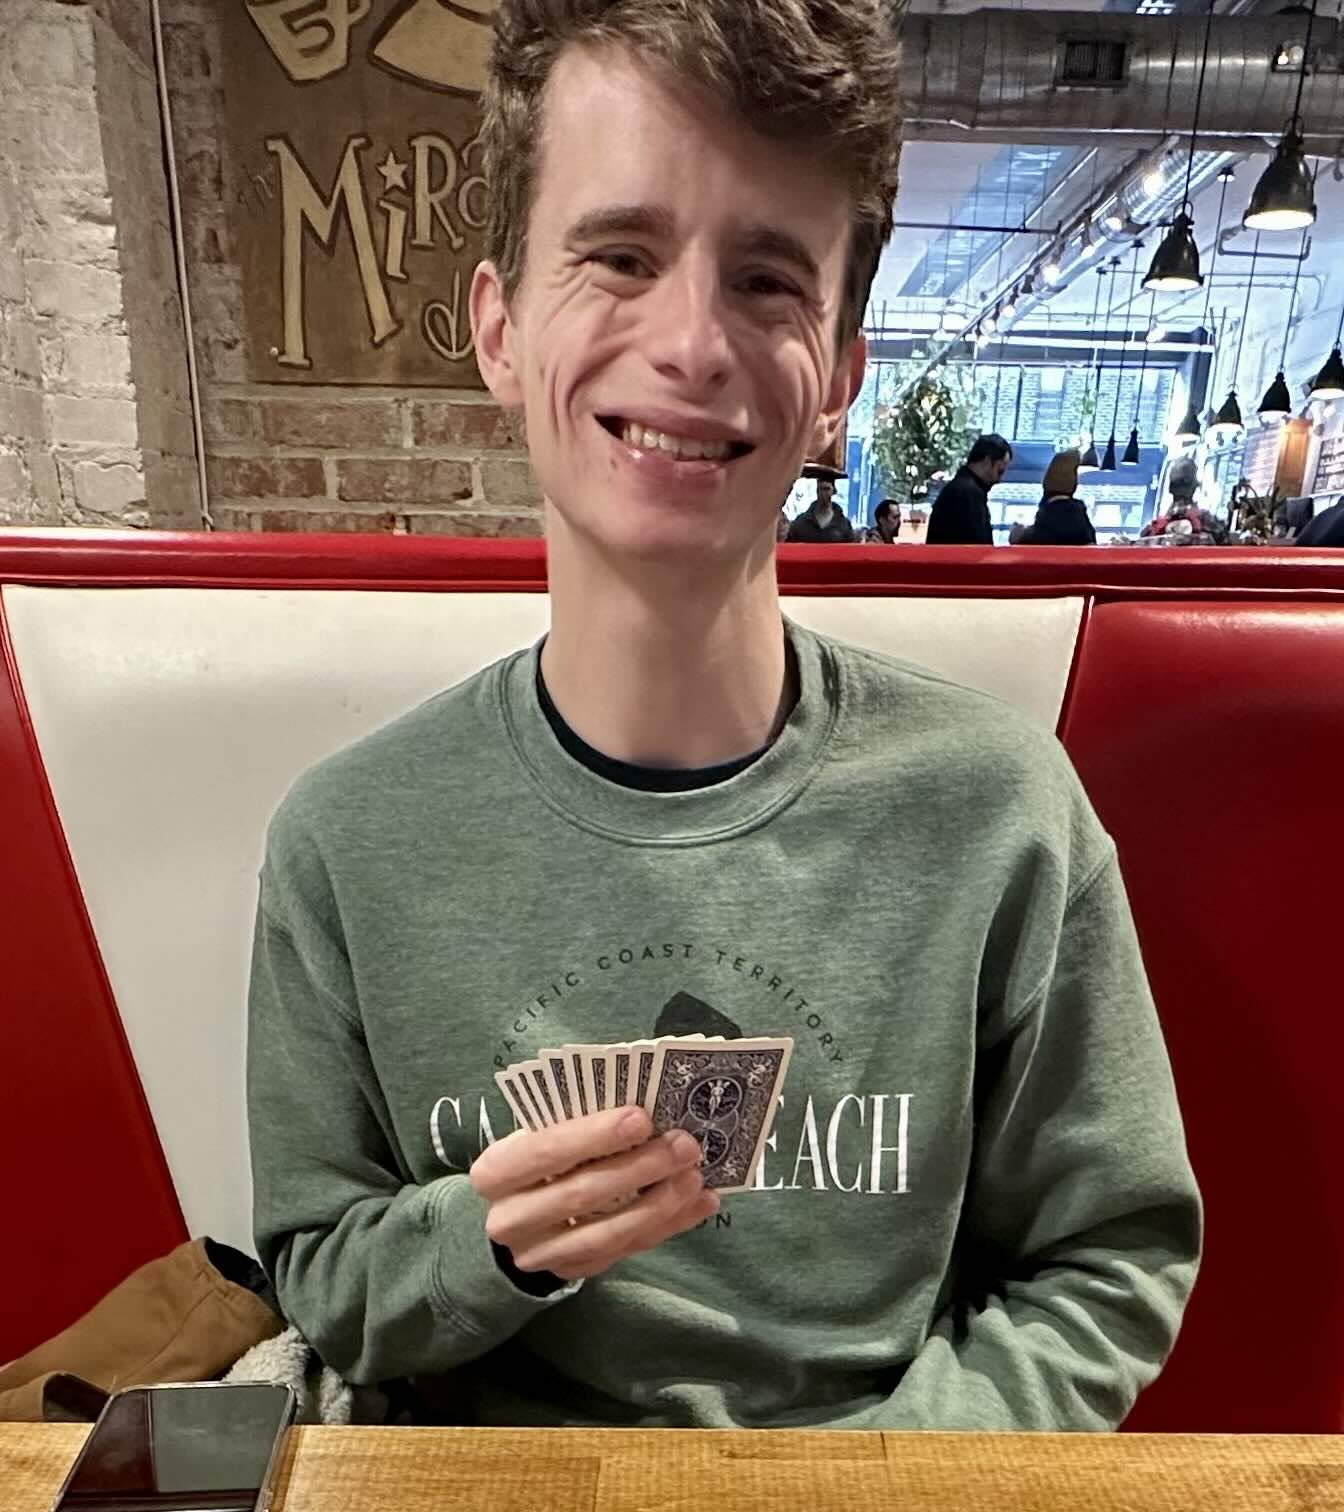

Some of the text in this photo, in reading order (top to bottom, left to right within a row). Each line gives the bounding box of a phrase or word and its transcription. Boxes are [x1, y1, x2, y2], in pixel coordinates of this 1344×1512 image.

[494, 943, 845, 1069] PACIFIC COAST TERRITORY
[748, 1093, 915, 1195] EACH
